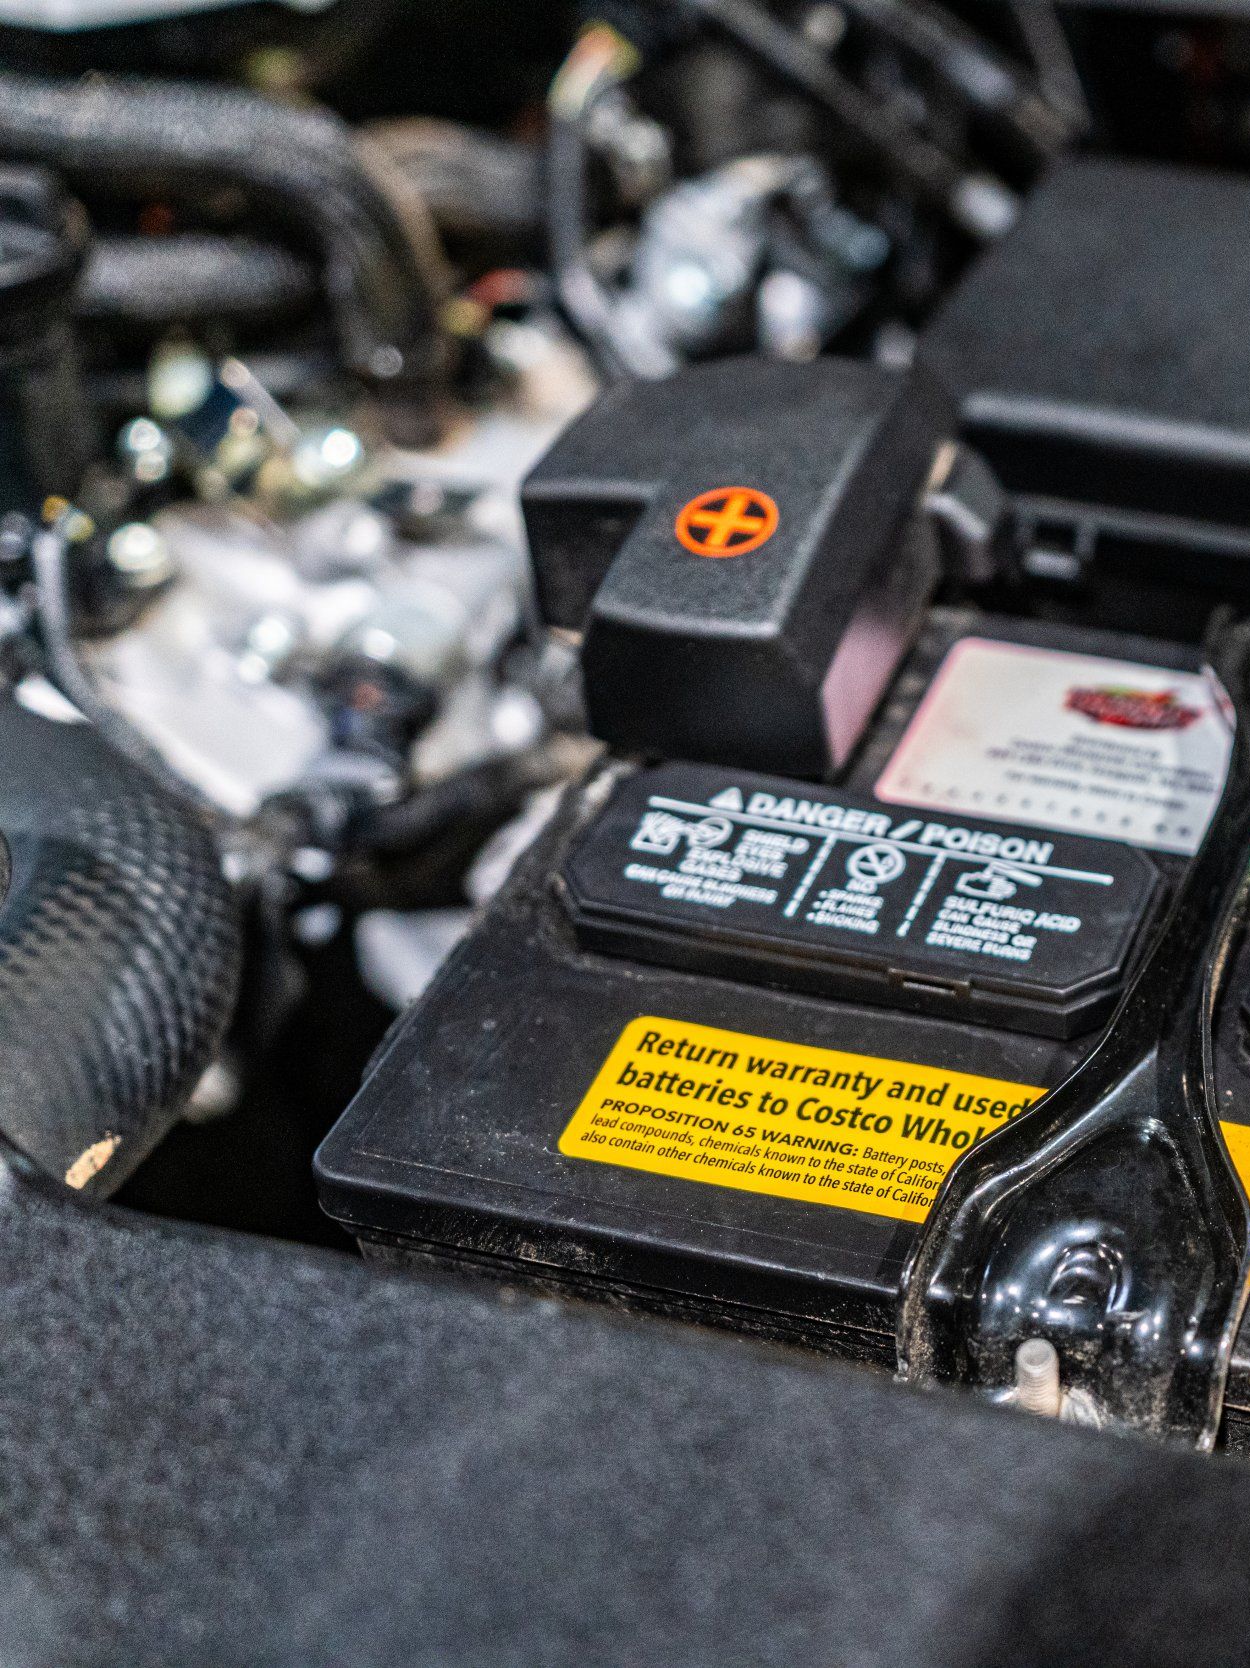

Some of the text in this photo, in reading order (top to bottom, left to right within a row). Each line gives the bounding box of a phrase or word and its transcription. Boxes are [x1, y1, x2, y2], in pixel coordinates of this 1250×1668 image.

[746, 792, 892, 836] DANGER
[919, 822, 1054, 864] POISON
[685, 847, 789, 878] EXPLOSIVE
[846, 879, 878, 894] NO
[932, 919, 1037, 949] BLINDNESS OR
[937, 908, 1022, 935] CAN CAUSE
[944, 895, 1081, 933] SULFURIC ACID
[925, 930, 1032, 962] SEVERE BURNS
[636, 1030, 739, 1069] Return
[746, 1056, 883, 1100] warranty
[886, 1080, 950, 1107] and
[616, 1061, 753, 1110] batteries
[757, 1091, 788, 1116] to
[796, 1097, 893, 1134] Costco
[590, 1113, 942, 1191] lead compounds, chemicals known to the state of Califor
[600, 1099, 947, 1176] PROPOSITION 65 WARNING: Battery posts,
[580, 1130, 607, 1144] also
[608, 1135, 655, 1154] contain
[657, 1145, 692, 1163] other
[693, 1153, 756, 1175] chemicals
[757, 1164, 801, 1184] known
[803, 1172, 817, 1185] to
[818, 1174, 839, 1189] the
[842, 1180, 874, 1196] state
[876, 1186, 891, 1199] of
